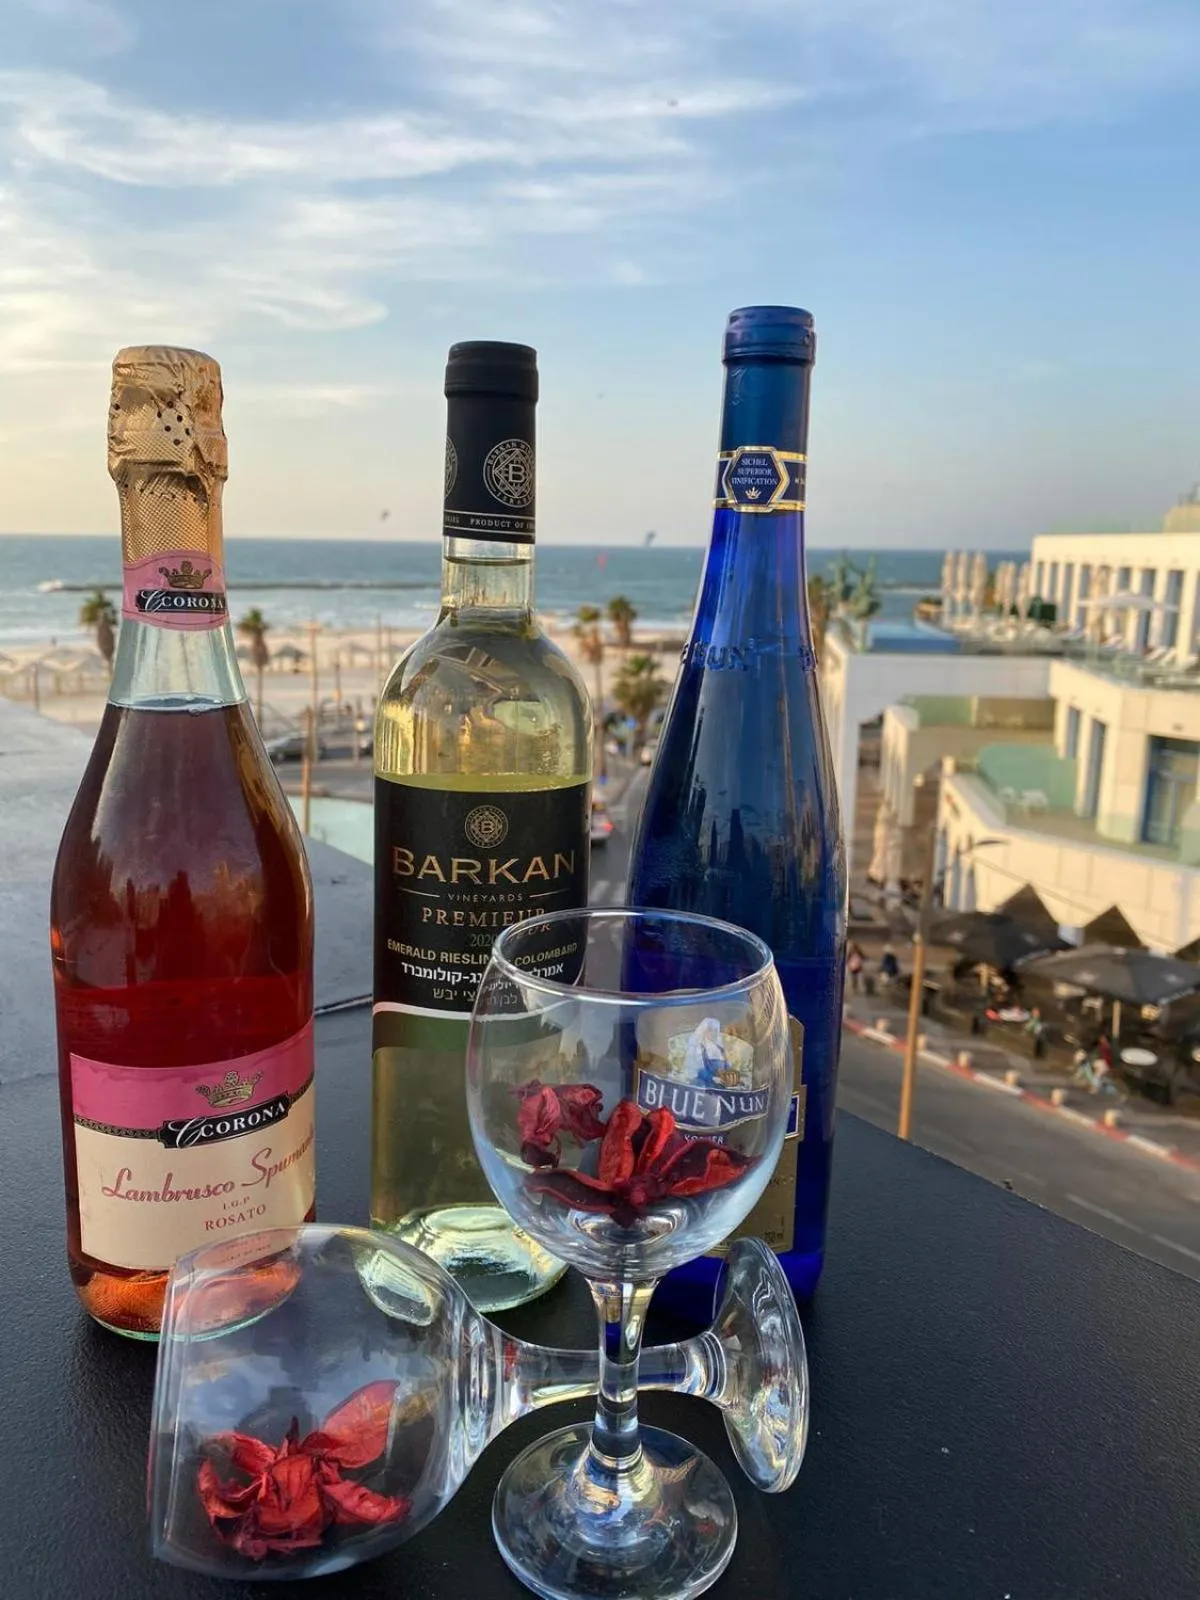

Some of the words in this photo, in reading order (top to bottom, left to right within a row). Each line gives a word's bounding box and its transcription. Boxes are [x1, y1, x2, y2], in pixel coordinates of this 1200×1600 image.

[470, 518, 512, 528] PRODUCT
[392, 846, 575, 885] BARKAN
[448, 892, 523, 902] VINEYARDS
[387, 939, 436, 961] EMERALD
[440, 951, 490, 966] RIESLIN
[645, 1079, 705, 1119] BLUE
[715, 1095, 765, 1118] NUN
[102, 1167, 236, 1202] Lambrusco
[205, 1204, 267, 1231] ROSATO
